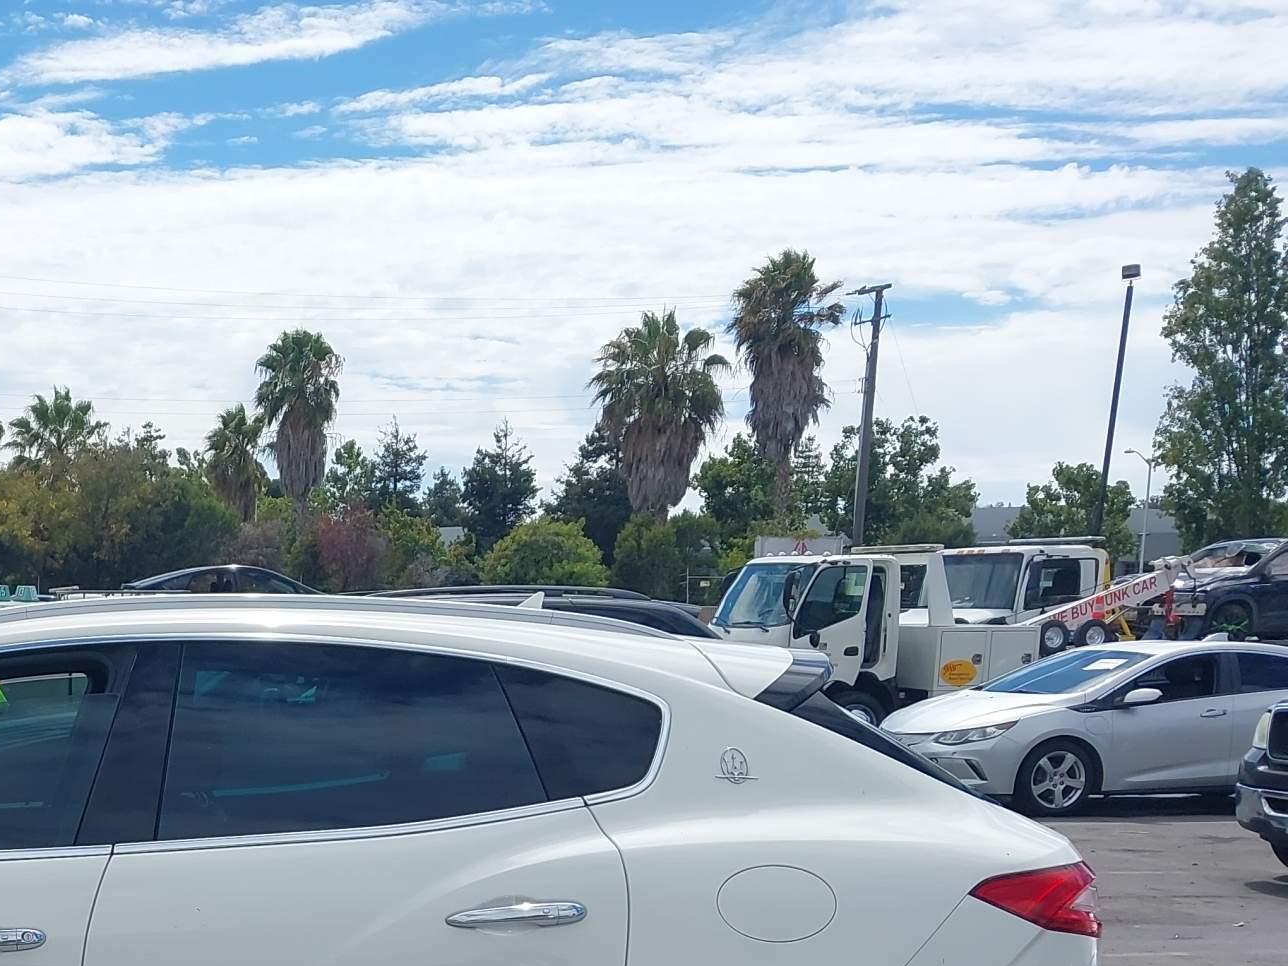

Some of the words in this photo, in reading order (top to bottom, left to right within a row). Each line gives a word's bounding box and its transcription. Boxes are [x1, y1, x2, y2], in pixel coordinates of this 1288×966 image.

[1071, 599, 1095, 619] BUY
[1105, 587, 1130, 606] UNK
[1132, 576, 1158, 595] CAR
